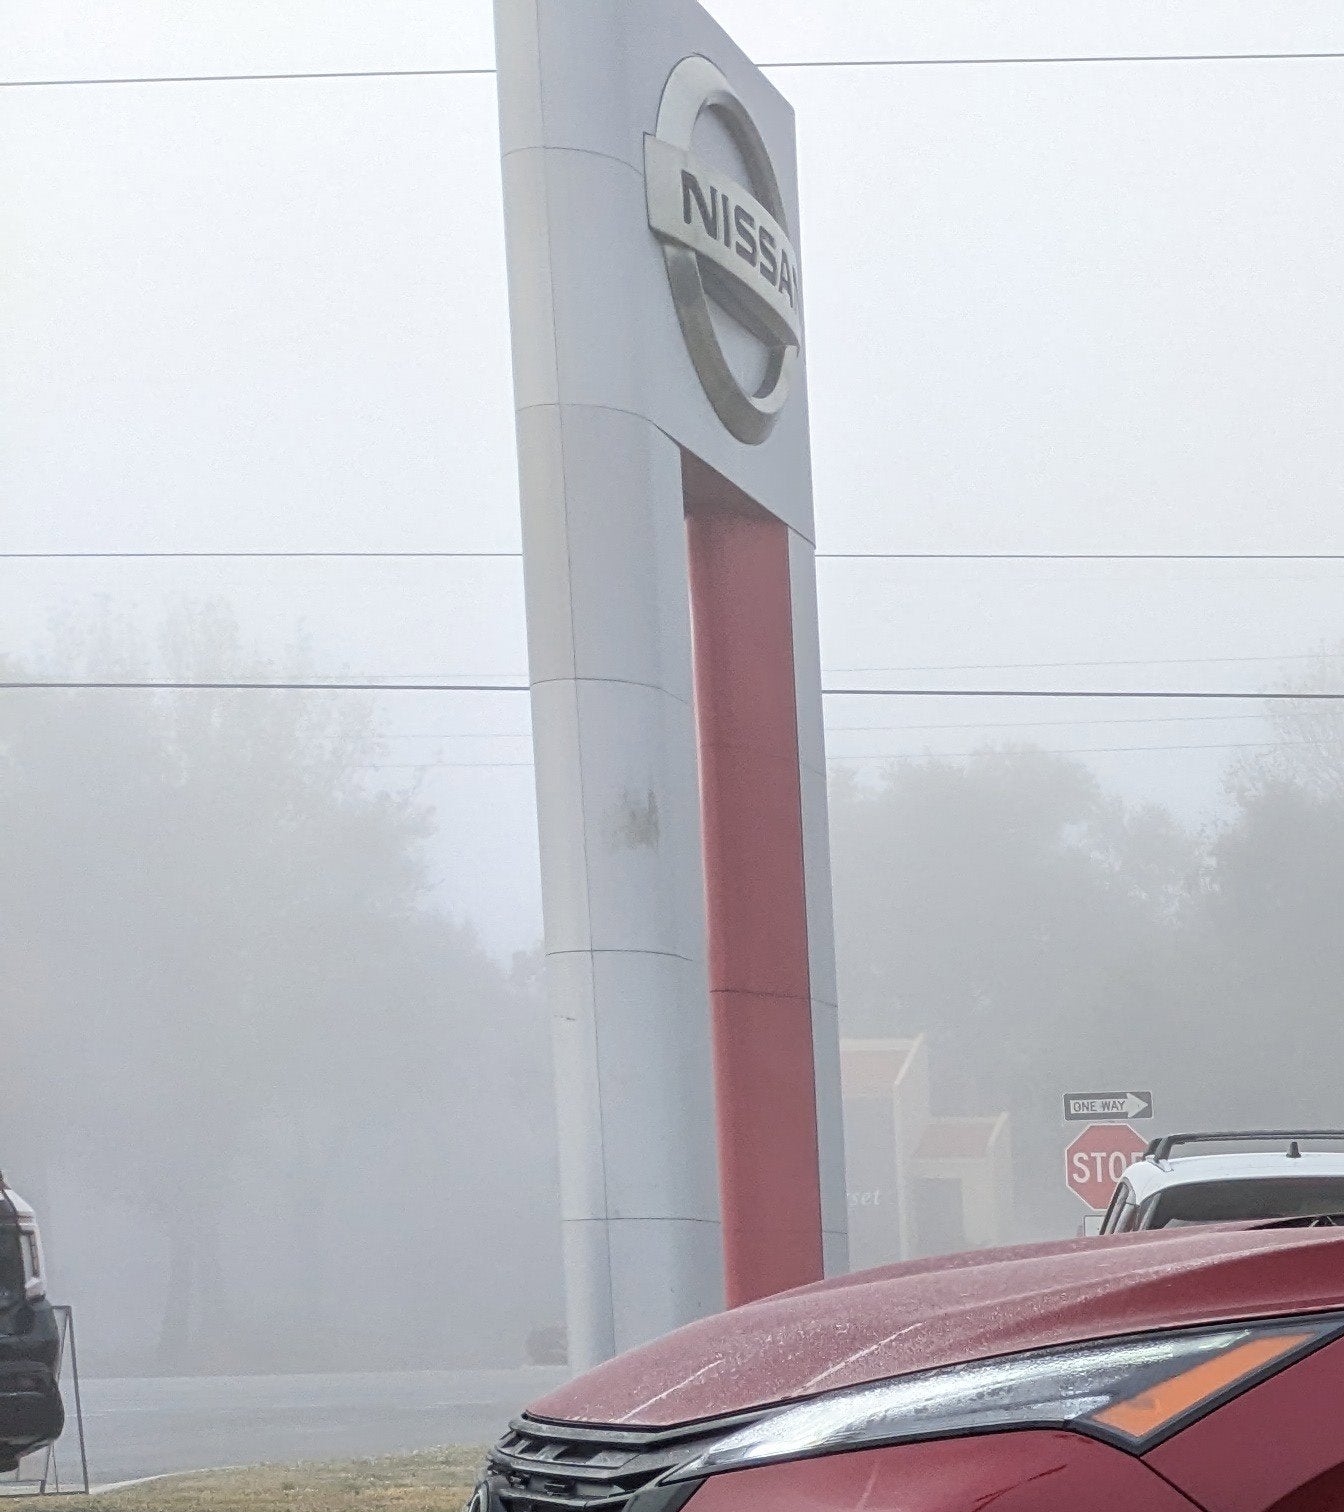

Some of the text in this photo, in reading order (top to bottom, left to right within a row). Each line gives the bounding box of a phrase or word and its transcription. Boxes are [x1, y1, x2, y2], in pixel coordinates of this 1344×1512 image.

[1073, 1100, 1125, 1112] ONE WAY
[1072, 1151, 1144, 1183] STO
